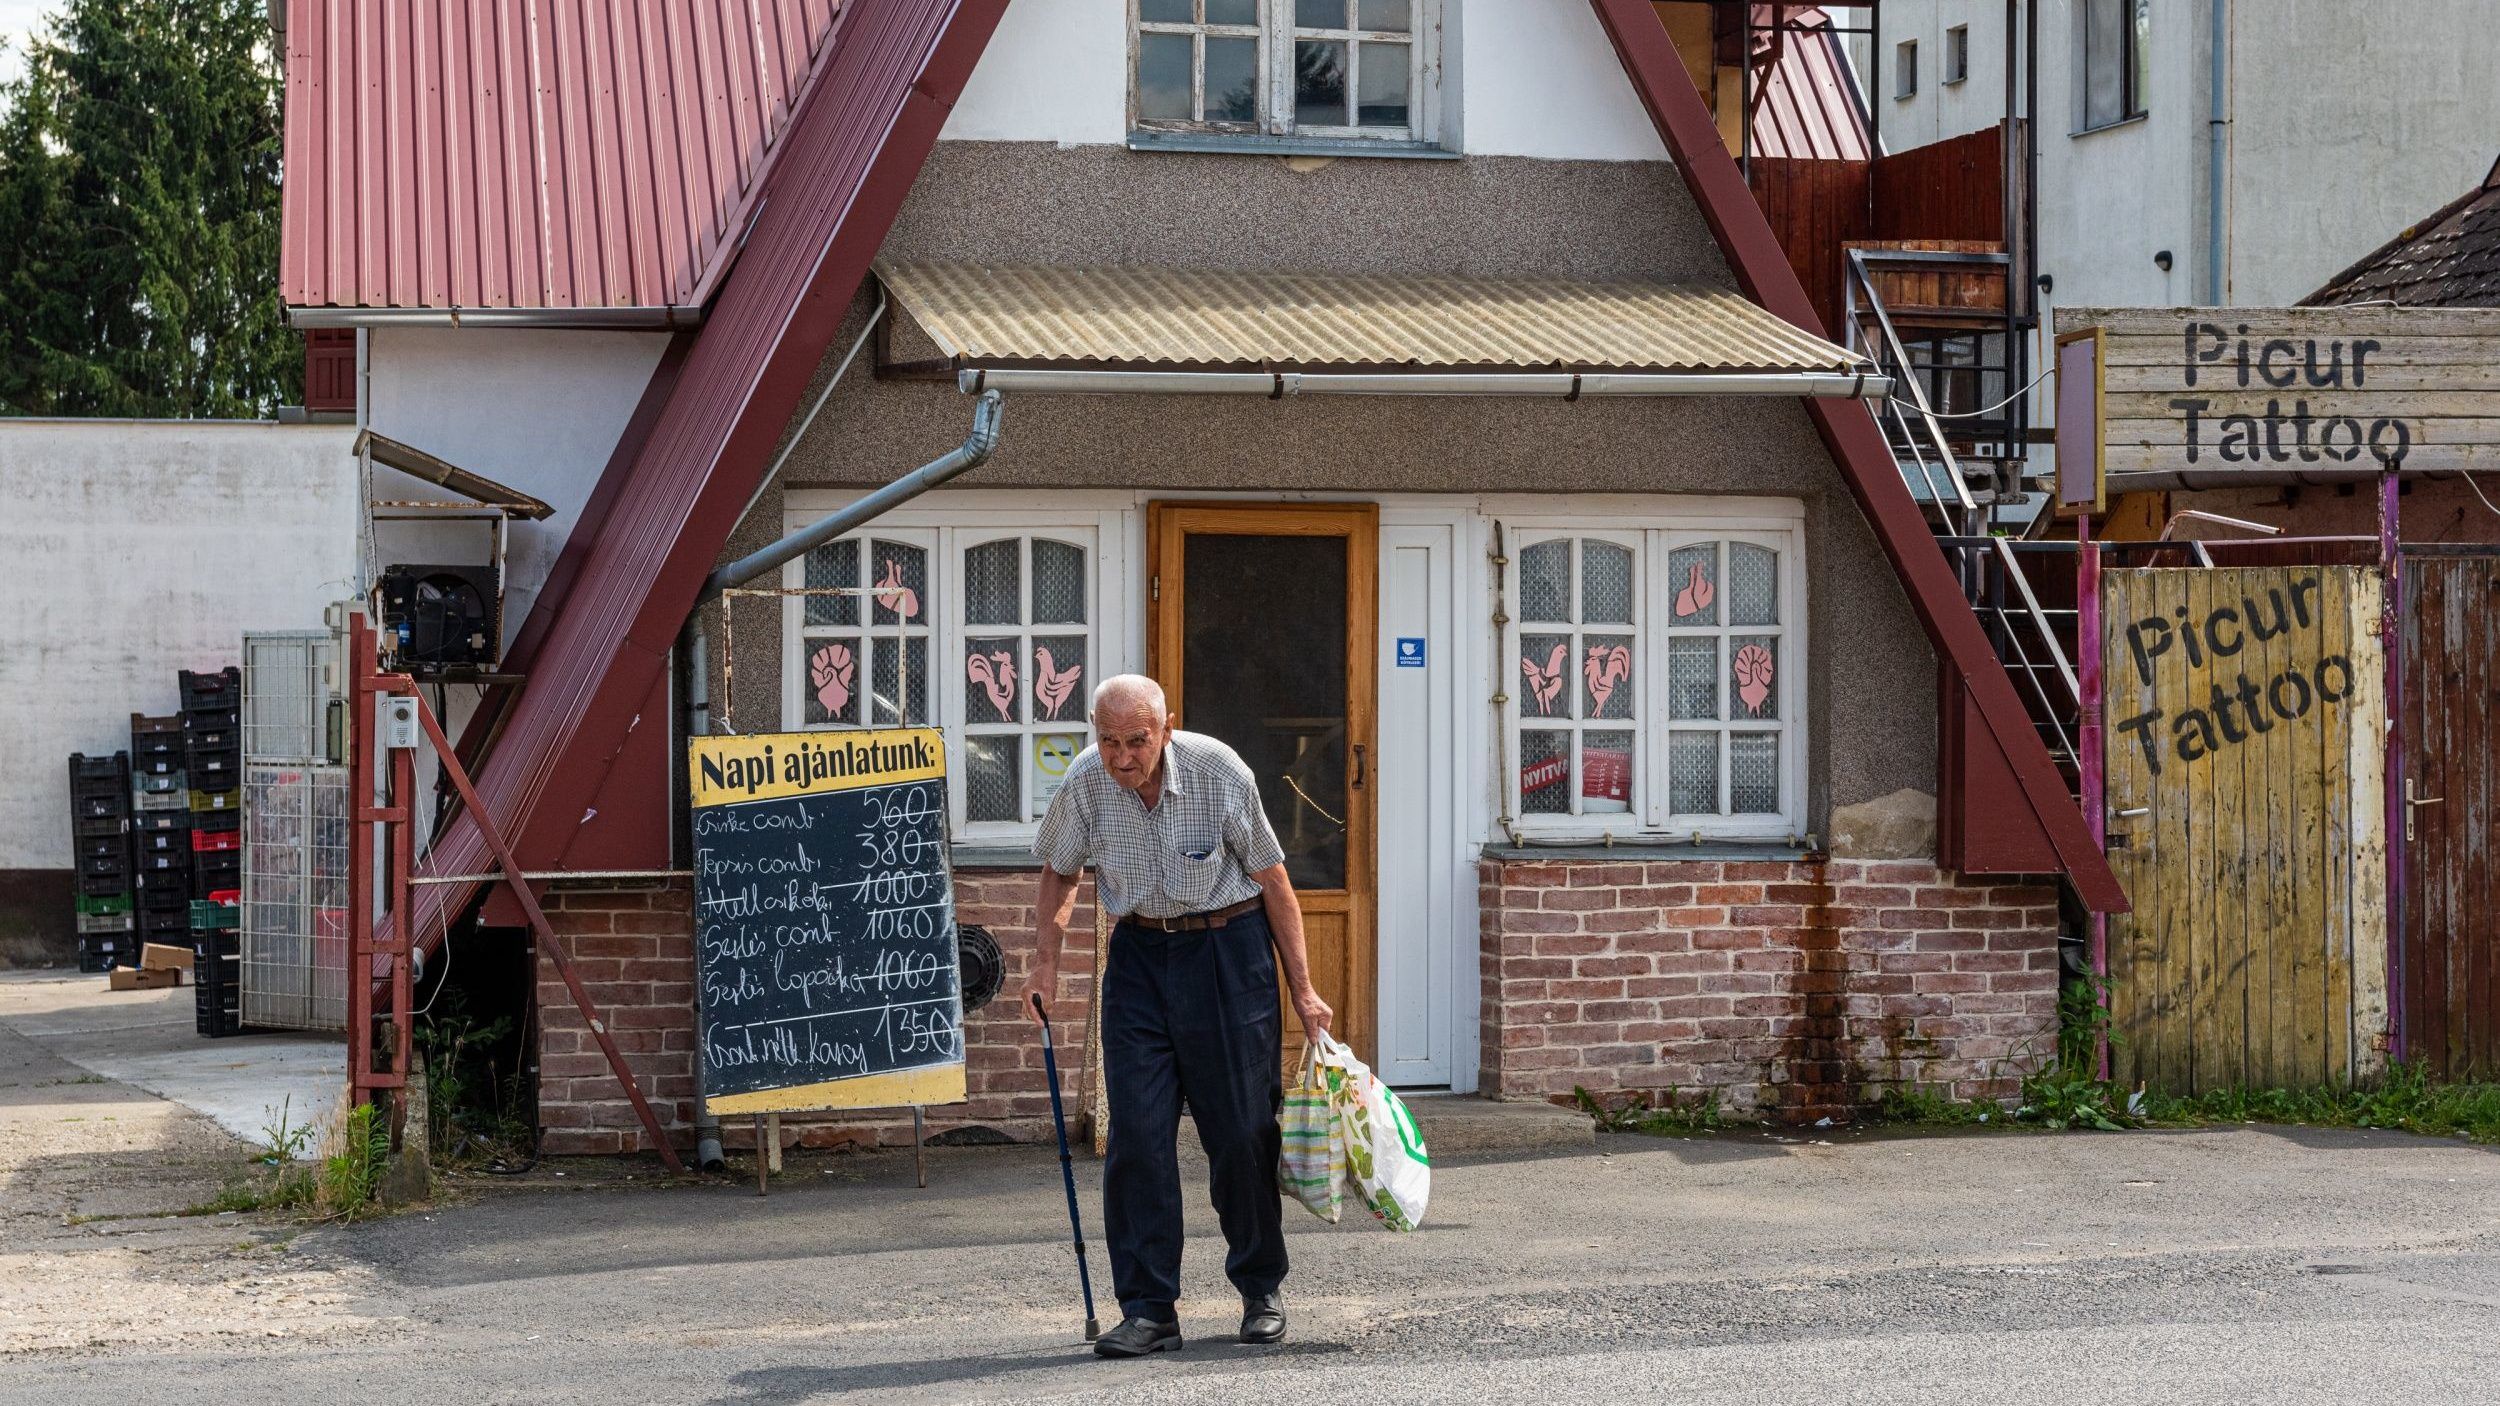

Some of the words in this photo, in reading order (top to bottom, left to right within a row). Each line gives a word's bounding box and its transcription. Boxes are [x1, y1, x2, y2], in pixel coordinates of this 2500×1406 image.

[2185, 322, 2382, 387] Picur
[2168, 398, 2411, 464] Tattoo
[2126, 577, 2317, 687] Picur
[2116, 654, 2355, 776] Tattoo
[700, 744, 775, 795] Napi
[784, 735, 936, 790] ajánlatunk:
[862, 787, 927, 829] 560
[856, 829, 921, 869] 380
[853, 871, 927, 904] 1000
[861, 907, 933, 940] 1060
[873, 949, 938, 991] 1060
[874, 1002, 955, 1063] 1350
